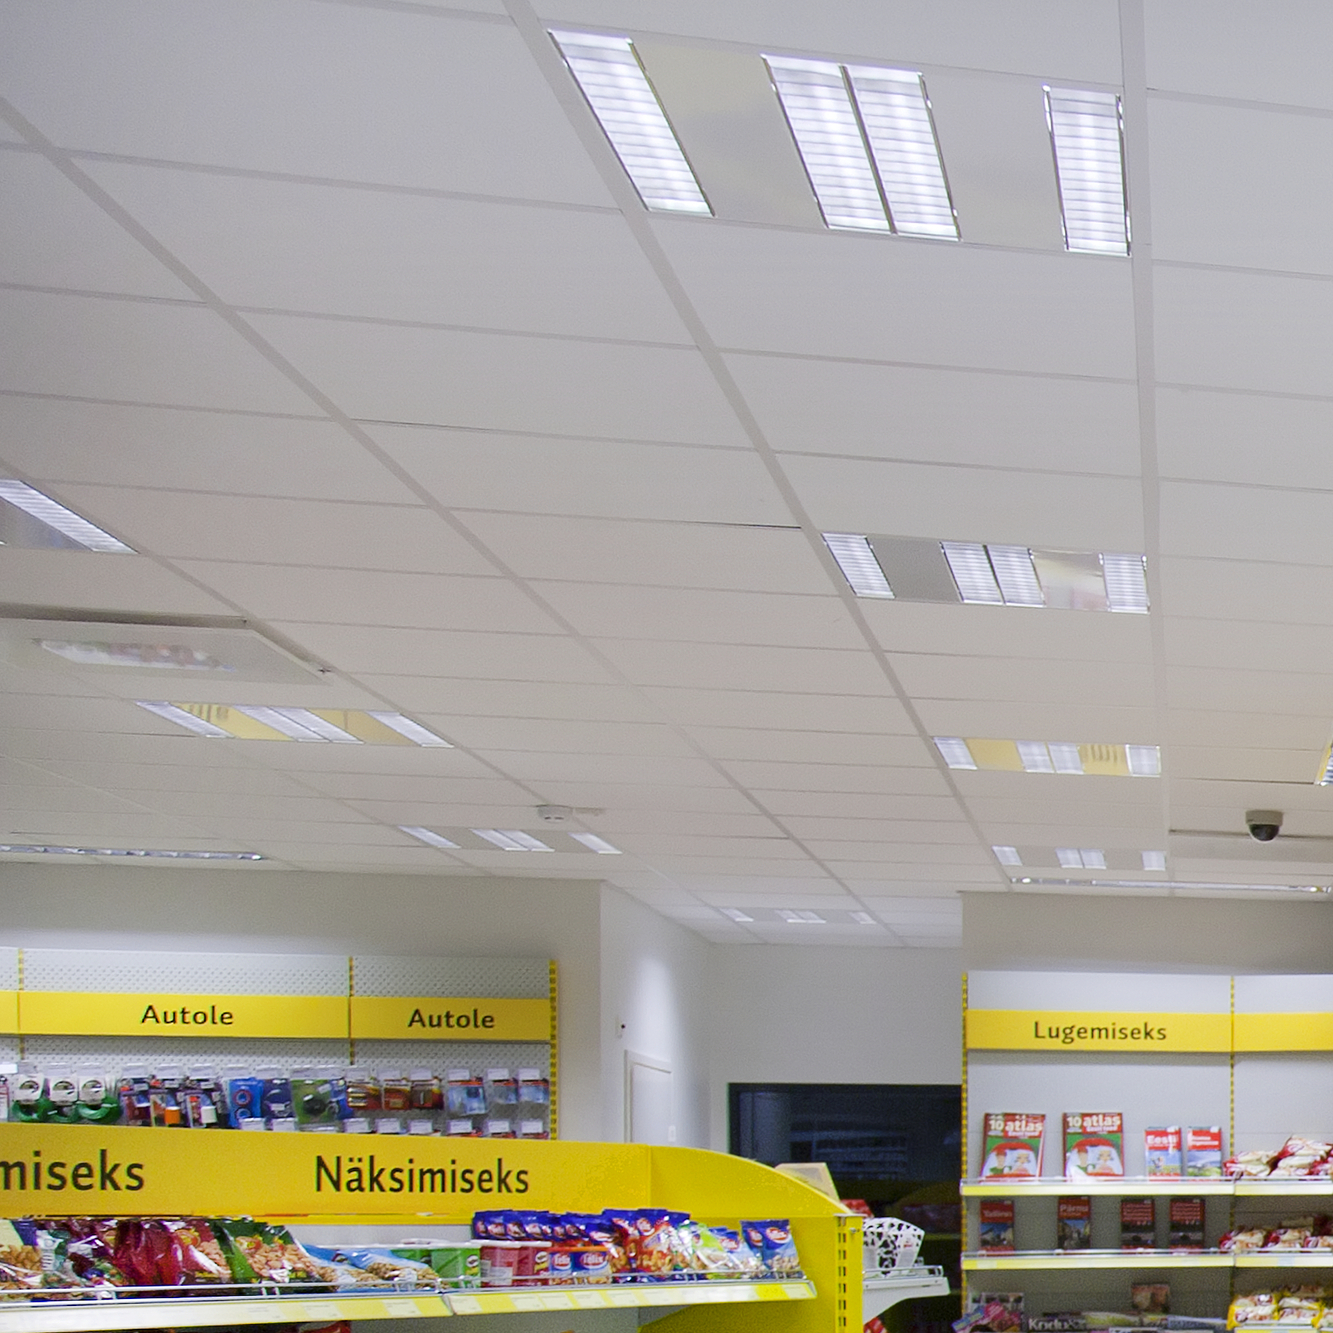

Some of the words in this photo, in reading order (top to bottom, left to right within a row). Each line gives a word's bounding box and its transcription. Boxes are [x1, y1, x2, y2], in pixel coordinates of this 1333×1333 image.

[141, 1004, 235, 1026] Autole
[407, 1008, 496, 1029] Autole
[1034, 1021, 1168, 1045] Lugemiseks
[1005, 1118, 1043, 1132] atlas
[1083, 1114, 1121, 1128] atlas
[315, 1155, 530, 1194] Näksimiseks
